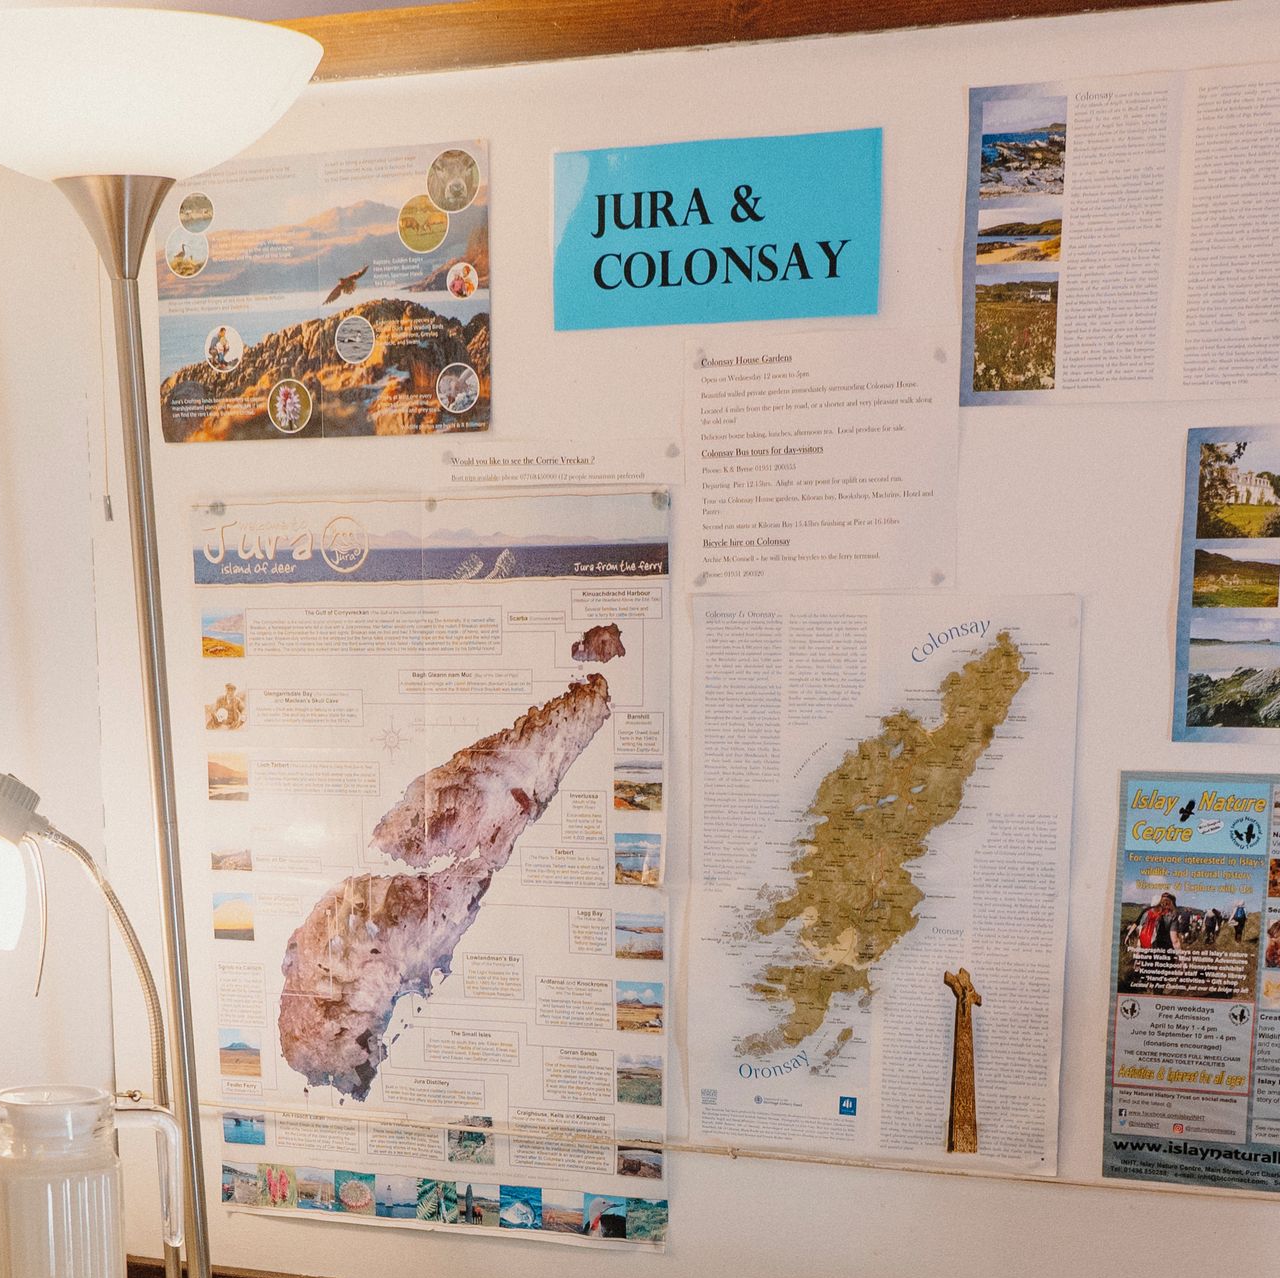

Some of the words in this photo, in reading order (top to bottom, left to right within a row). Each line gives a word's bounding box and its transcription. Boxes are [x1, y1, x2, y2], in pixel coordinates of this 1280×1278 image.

[1075, 91, 1114, 101] Colonsay
[591, 186, 714, 239] JURA
[730, 184, 766, 224] &
[593, 238, 852, 291] COLONSAY
[701, 358, 734, 367] Colonsay
[735, 356, 760, 365] House
[761, 354, 793, 363] Gardens
[701, 449, 734, 458] Colonsay
[736, 448, 750, 456] Bus
[750, 447, 770, 456] tours
[771, 446, 782, 454] for
[451, 458, 474, 466] Would
[536, 456, 558, 464] Corrie
[203, 521, 314, 565] Jura
[702, 538, 728, 548] Bicycle
[730, 538, 744, 546] hire
[756, 537, 791, 547] Colonsay
[331, 551, 357, 564] Jura
[221, 562, 251, 575] island
[254, 562, 269, 573] of
[271, 563, 297, 574] deer
[574, 561, 595, 572] Jura
[596, 561, 619, 572] from
[619, 560, 636, 572] the
[638, 560, 663, 573] ferry
[705, 610, 737, 620] Colonsay
[747, 610, 776, 620] Oronsay
[910, 620, 991, 663] Colonsay
[1131, 788, 1180, 816] Islay
[1198, 790, 1268, 813] Nature
[1132, 820, 1194, 844] Centre
[576, 910, 592, 918] Lagg
[931, 926, 965, 937] Oronsay
[1155, 1003, 1176, 1012] Open
[1177, 1006, 1215, 1014] weekdays
[1144, 1040, 1178, 1048] (donations
[1180, 1042, 1222, 1052] encouraged)
[738, 1048, 811, 1079] Oronsay
[1258, 1078, 1276, 1086] Islay
